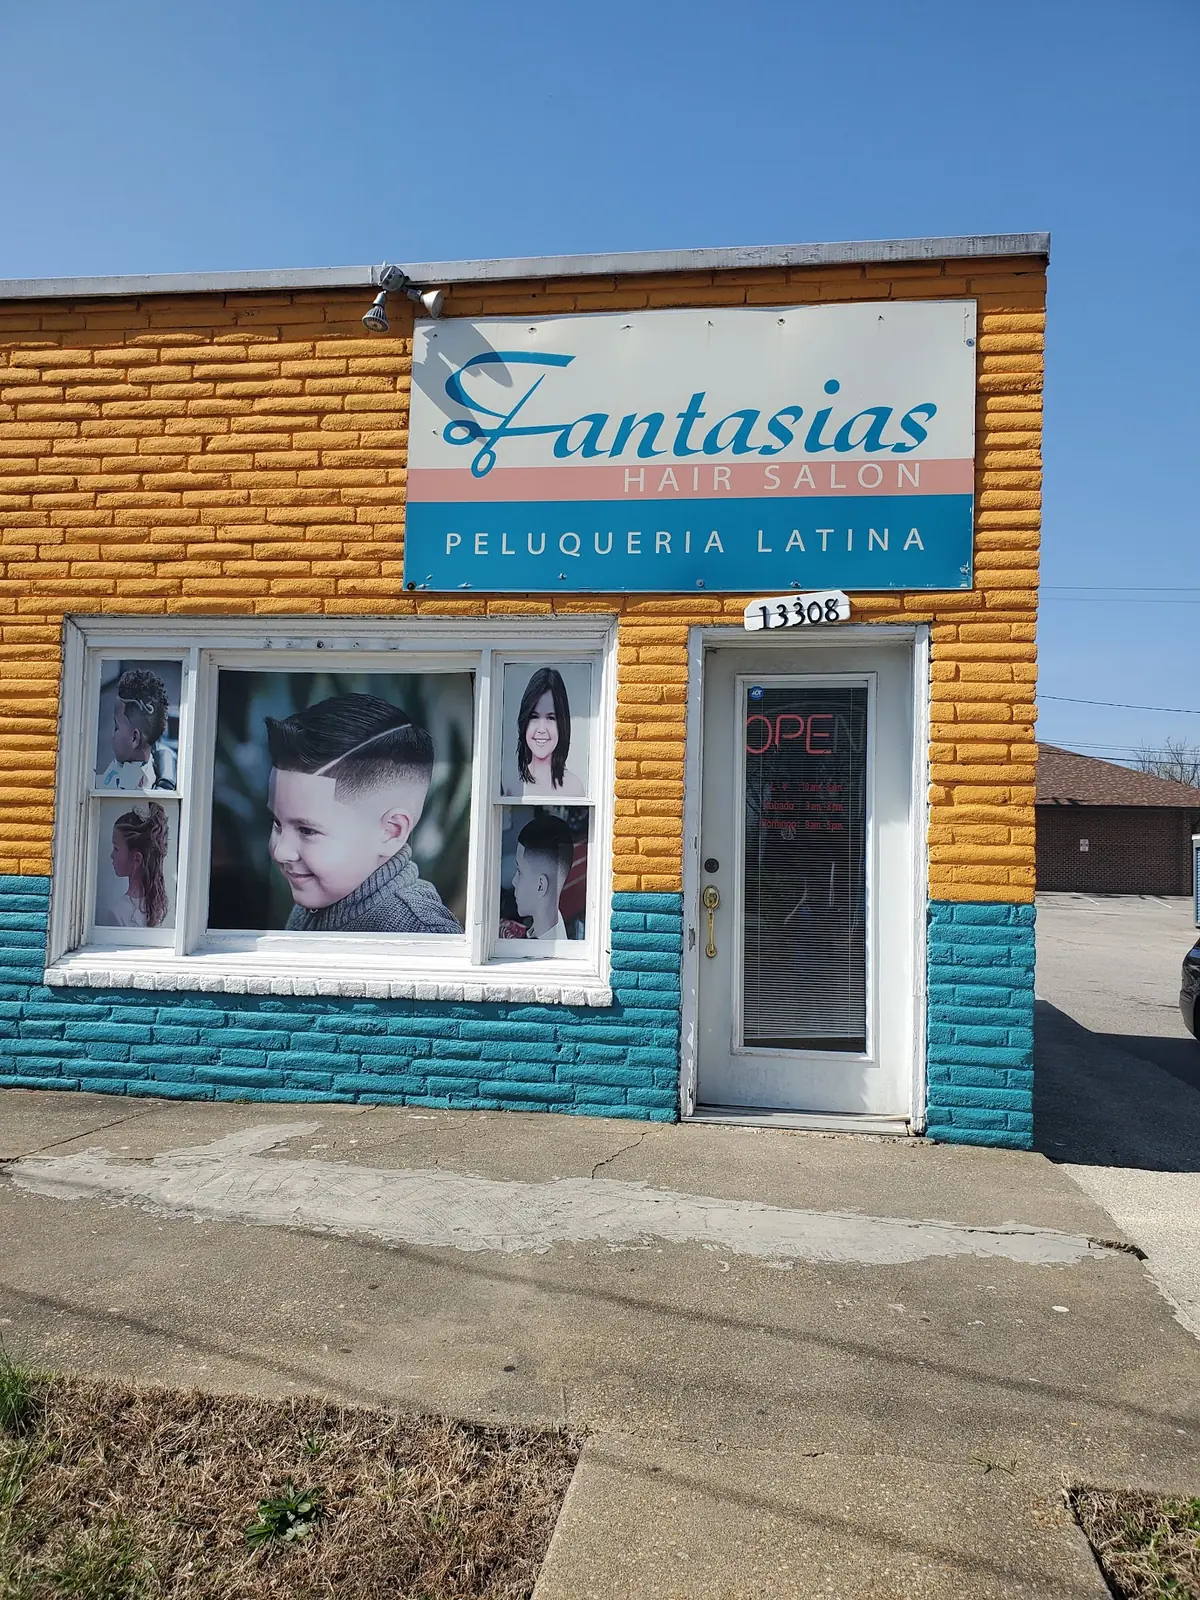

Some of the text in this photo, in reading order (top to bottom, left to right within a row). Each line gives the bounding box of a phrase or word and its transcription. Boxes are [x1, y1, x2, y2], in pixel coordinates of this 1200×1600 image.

[443, 350, 938, 479] Fantasias
[623, 462, 921, 493] HAIR SALON
[445, 527, 925, 557] PELUQUERIA LATINA
[758, 598, 840, 630] 13308
[746, 714, 865, 754] OPEN
